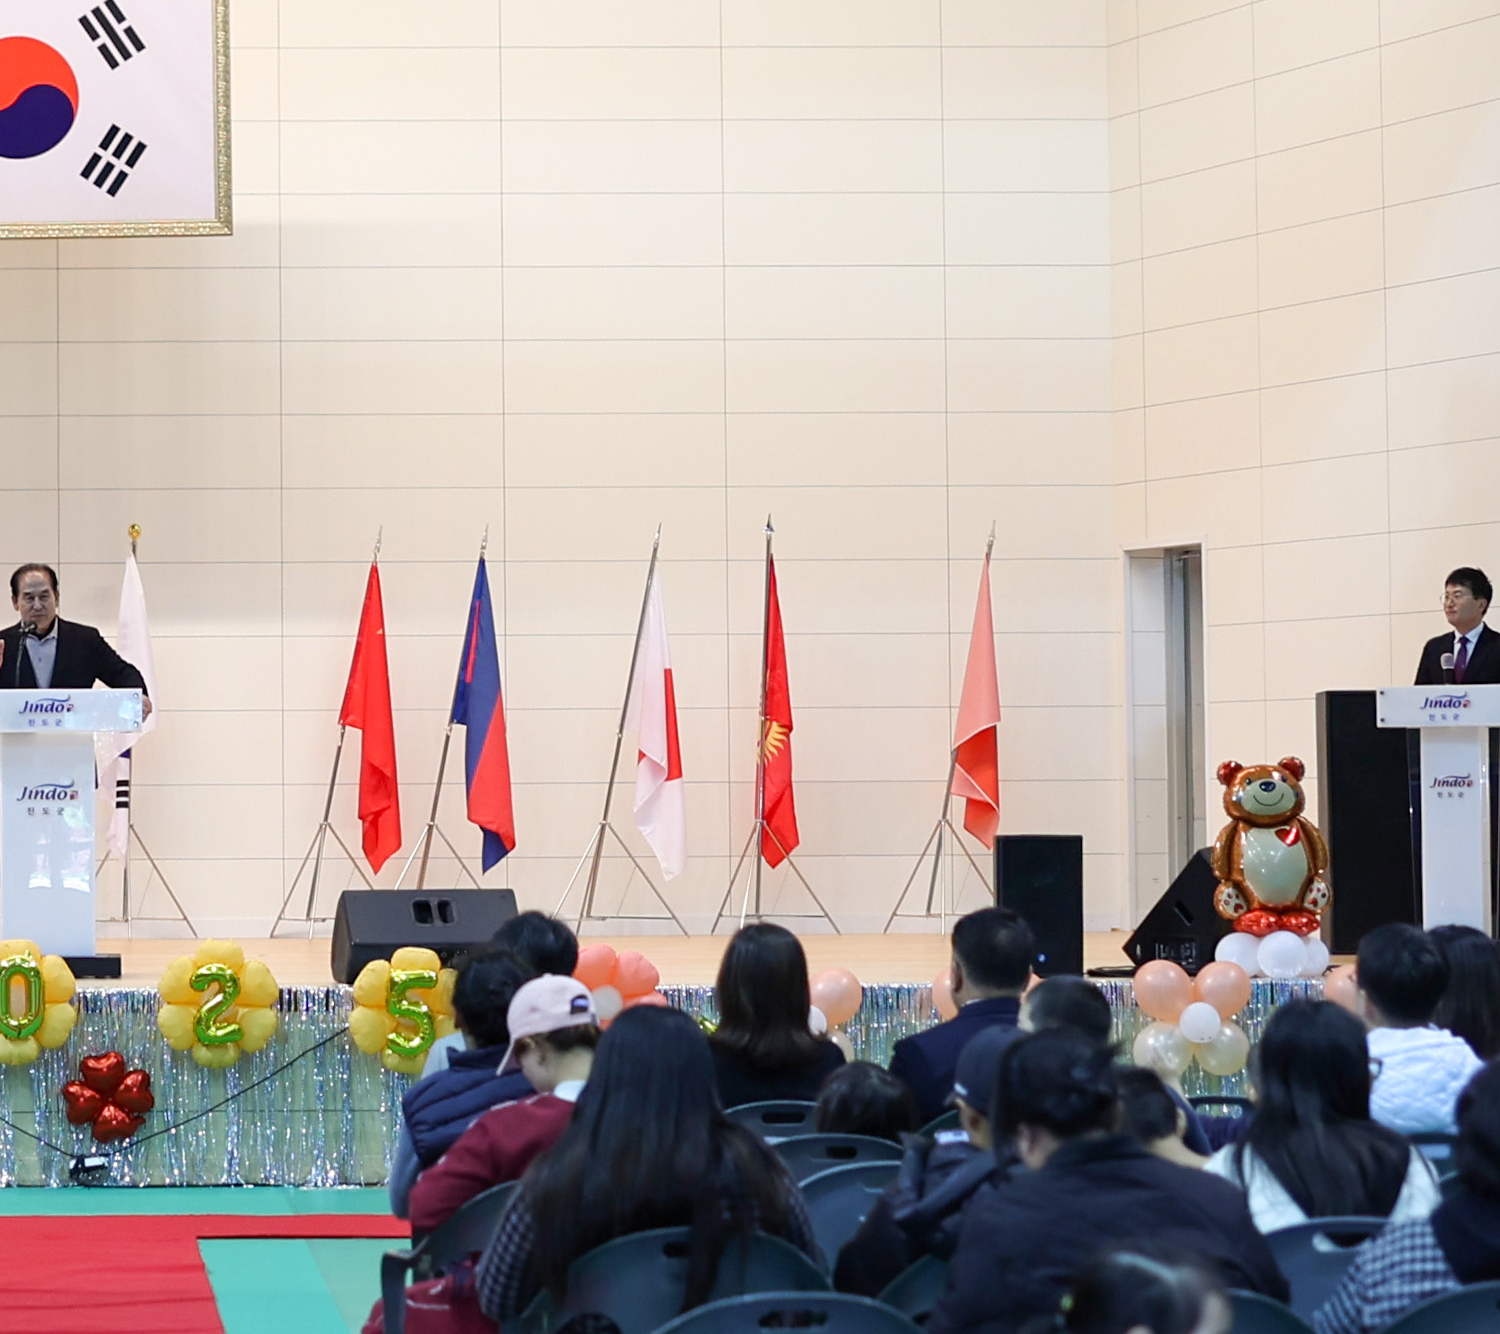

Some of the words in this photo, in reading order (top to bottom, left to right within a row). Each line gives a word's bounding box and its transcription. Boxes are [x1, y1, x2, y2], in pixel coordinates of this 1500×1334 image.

[18, 698, 66, 715] Jindo
[1420, 695, 1463, 710] Jindo
[1429, 776, 1466, 789] Jindo
[16, 784, 69, 802] Jindo
